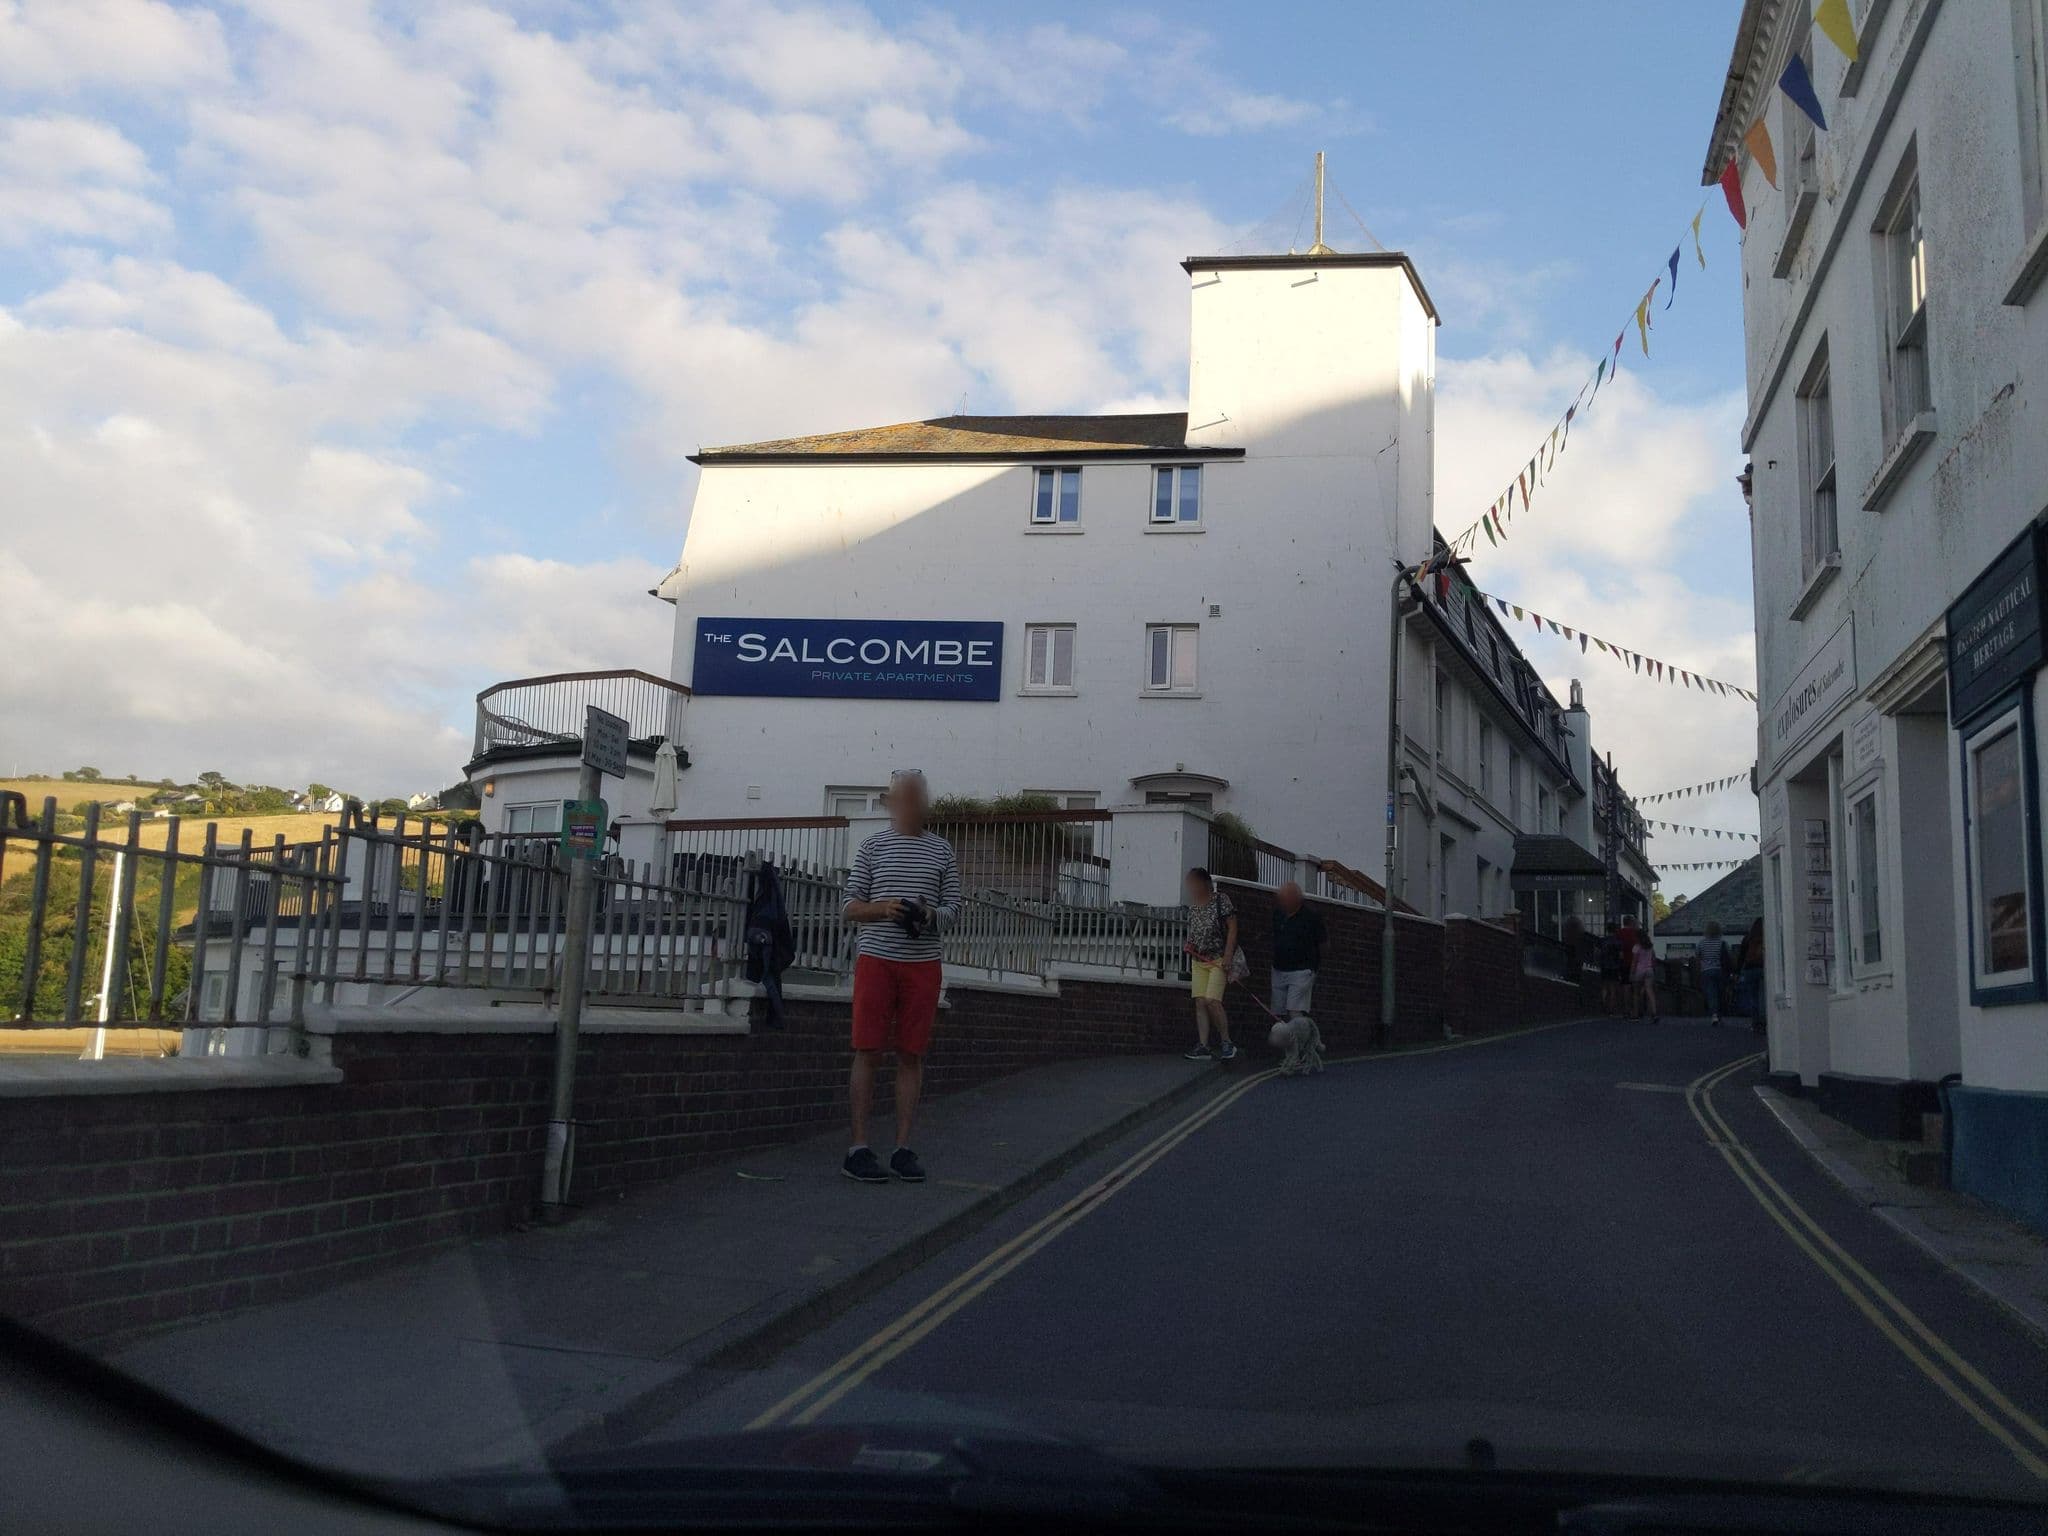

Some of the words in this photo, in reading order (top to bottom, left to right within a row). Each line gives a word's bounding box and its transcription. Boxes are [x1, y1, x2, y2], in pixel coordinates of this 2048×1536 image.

[1988, 576, 2032, 625] NAUTICAL
[704, 632, 732, 644] THE
[736, 633, 993, 666] SALCOMBE
[1973, 620, 2015, 669] HERITAGE
[811, 670, 872, 682] PRIVATE
[875, 671, 974, 684] APARTMENTS
